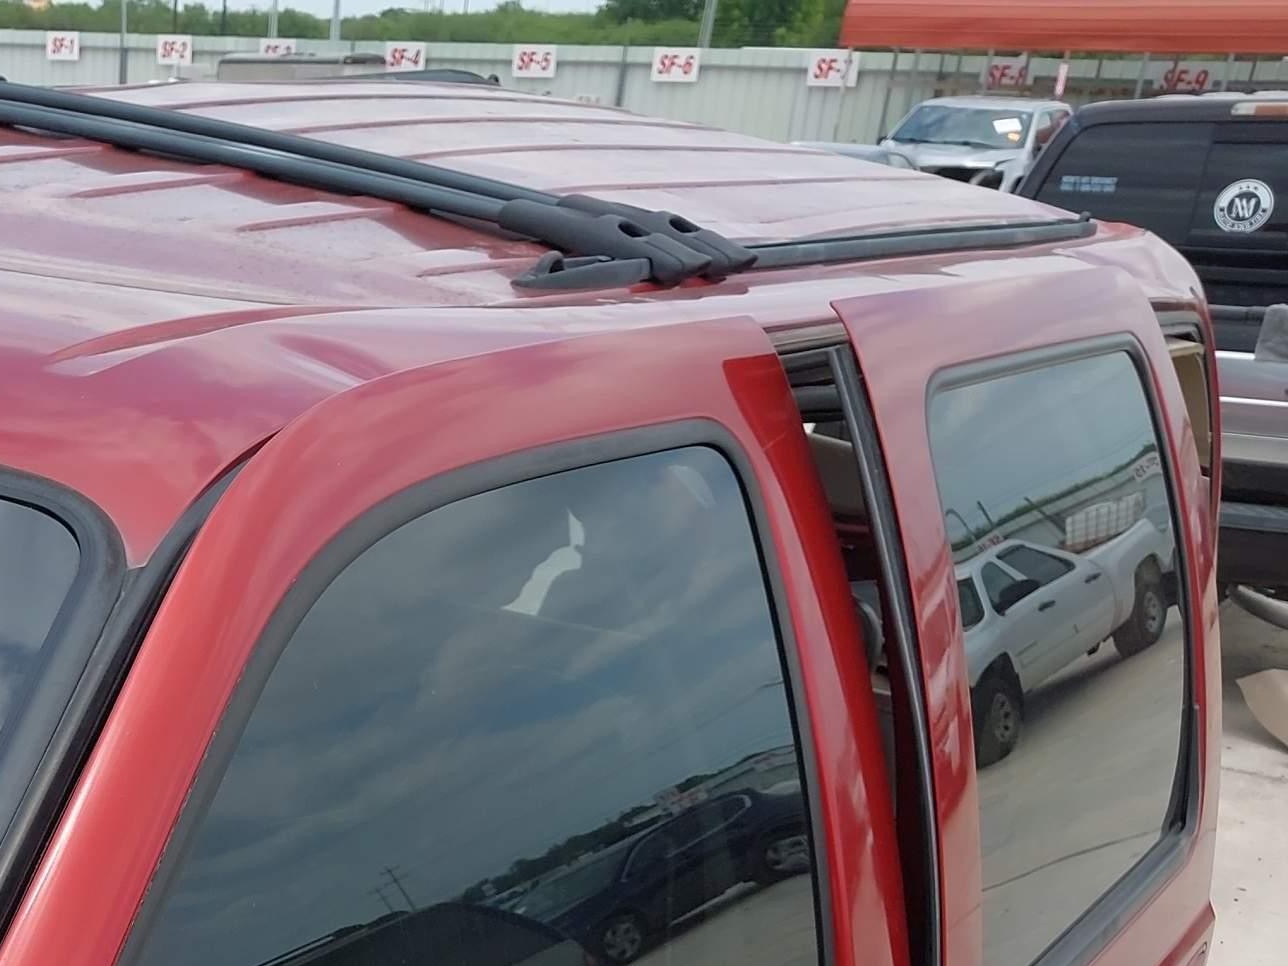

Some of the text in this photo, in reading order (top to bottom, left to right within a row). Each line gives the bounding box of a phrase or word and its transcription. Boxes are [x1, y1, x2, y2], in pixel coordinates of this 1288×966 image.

[391, 48, 421, 66] SF-4
[517, 51, 552, 71] SF-5
[657, 54, 695, 75] SF-6
